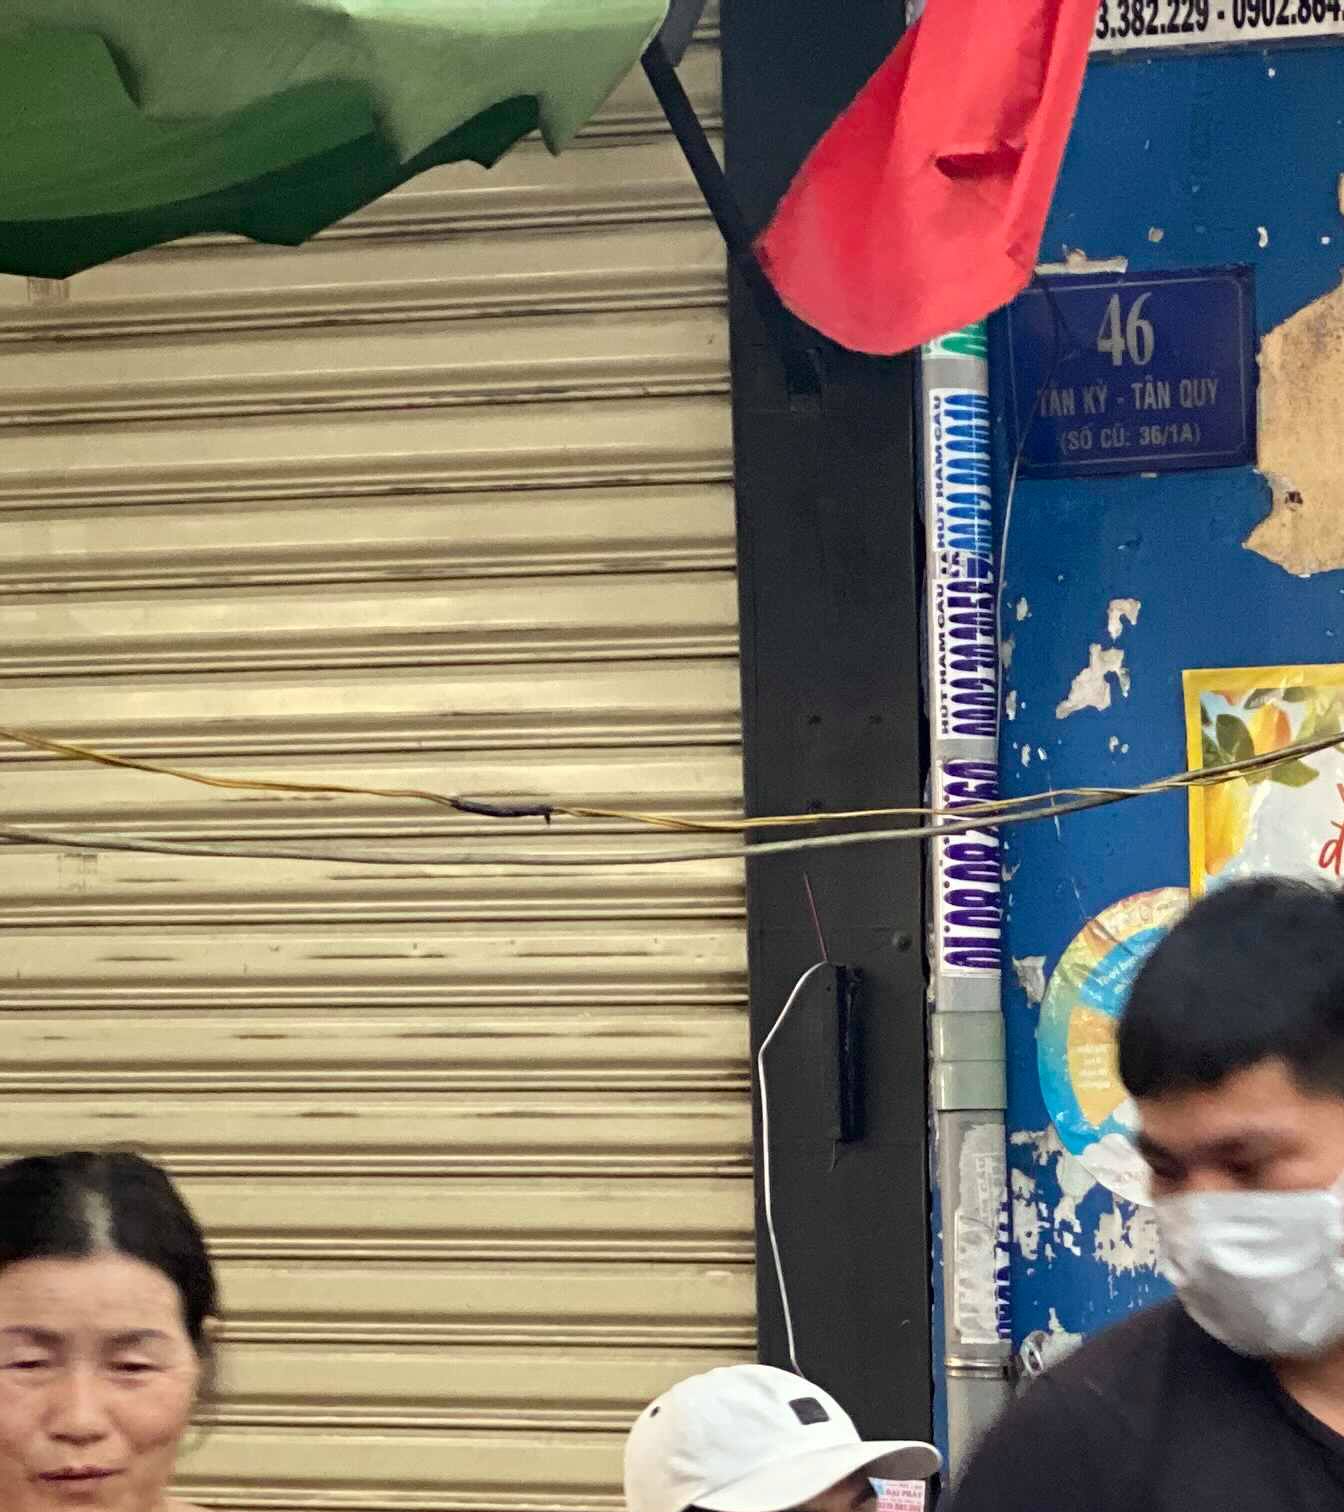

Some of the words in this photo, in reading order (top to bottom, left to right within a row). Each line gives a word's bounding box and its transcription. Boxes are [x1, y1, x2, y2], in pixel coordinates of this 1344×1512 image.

[1095, 0, 1208, 38] 3.382.229
[1096, 291, 1156, 367] 46
[1130, 375, 1171, 411] TÂN
[1137, 421, 1202, 448] 36/1A)
